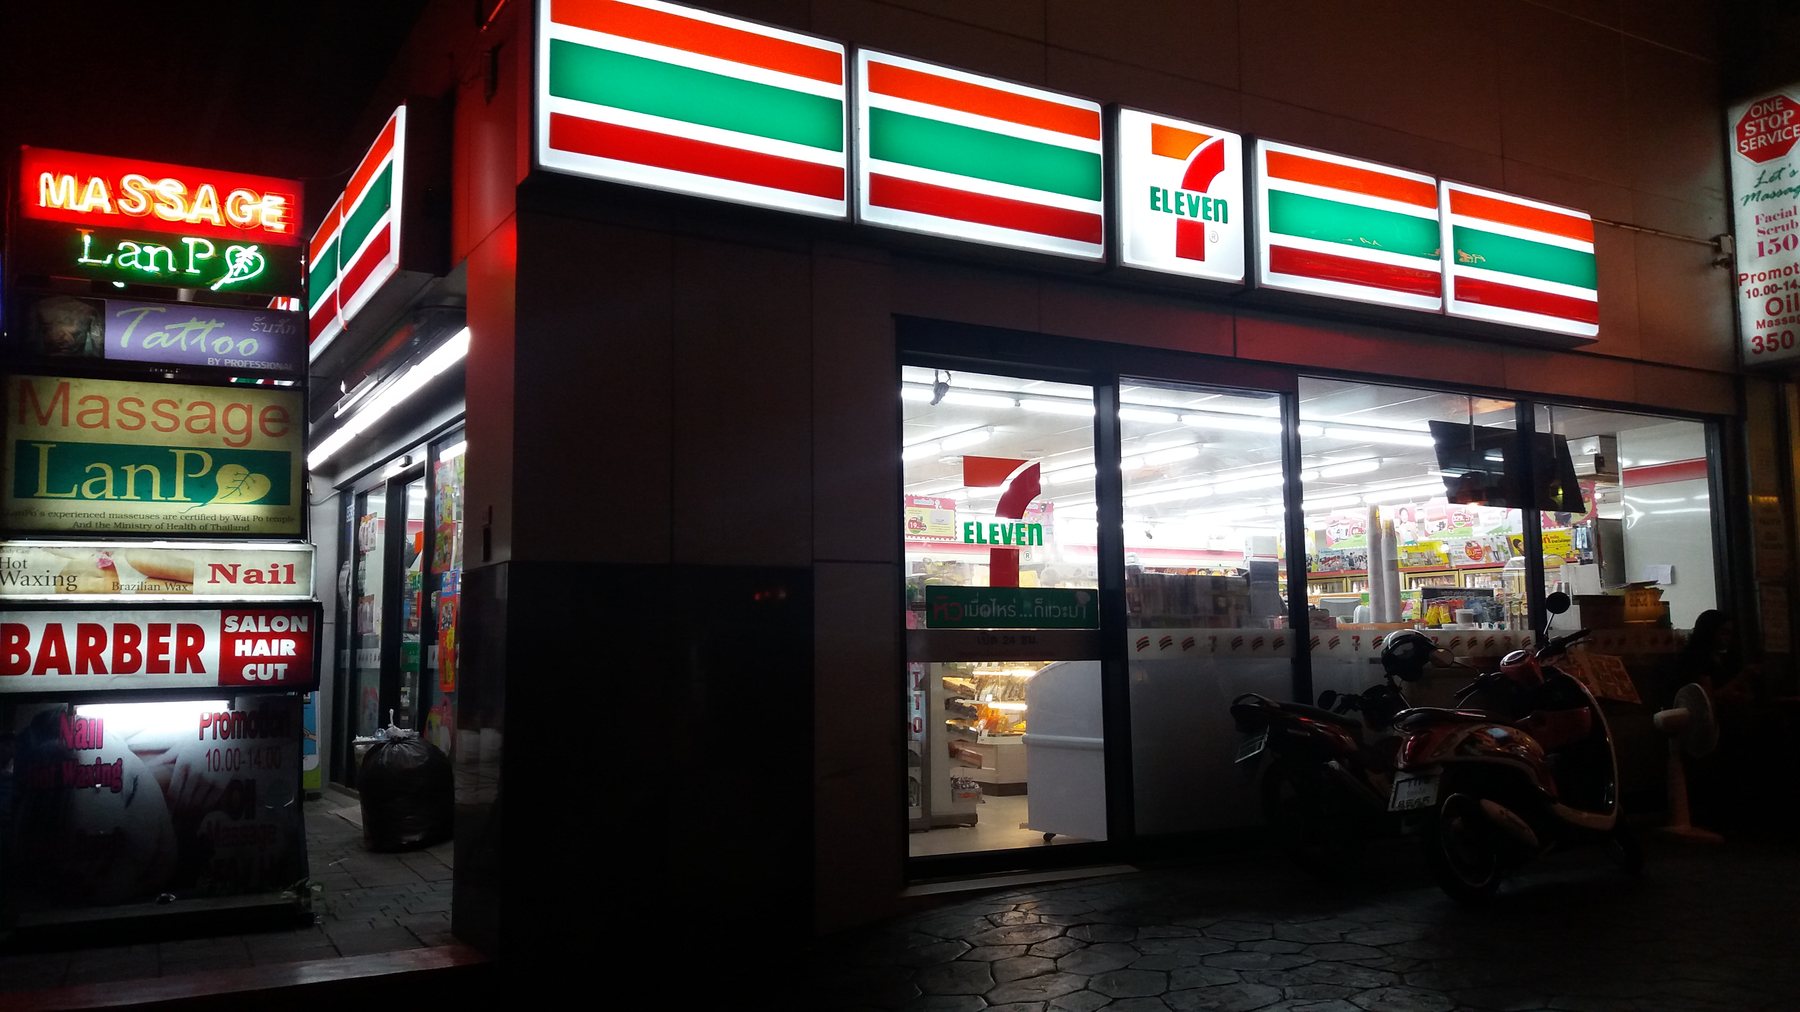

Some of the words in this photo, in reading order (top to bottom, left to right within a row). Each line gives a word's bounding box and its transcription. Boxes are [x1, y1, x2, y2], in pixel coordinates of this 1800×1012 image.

[1750, 97, 1784, 118] ONE
[1744, 109, 1795, 137] STOP
[1740, 123, 1800, 153] SERVICE
[1754, 163, 1799, 188] Let's
[38, 171, 292, 234] MASSAGE
[1754, 205, 1798, 225] Facial
[1756, 219, 1799, 238] Scrub
[1757, 234, 1799, 258] 150
[1765, 292, 1800, 316] Oil
[116, 306, 259, 357] Tattoo
[1751, 330, 1794, 355] 350
[207, 357, 221, 366] BY
[224, 359, 293, 370] PROFESSIONAL
[18, 378, 292, 448] Massage
[47, 510, 106, 520] experienced
[108, 512, 160, 520] masseuses
[180, 513, 216, 521] certified
[219, 514, 230, 523] by
[232, 514, 250, 522] Wat
[252, 514, 264, 522] Po
[72, 521, 92, 529] And
[95, 521, 110, 529] the
[114, 521, 152, 531] Ministry
[155, 522, 164, 530] of
[166, 522, 197, 530] Health
[199, 523, 208, 531] of
[210, 523, 250, 532] Thailand
[0, 557, 28, 569] Hot
[207, 562, 297, 585] Nail
[0, 569, 78, 591] Waxing
[111, 581, 161, 591] Brazilian
[163, 582, 188, 591] Wax
[223, 615, 309, 633] SALON
[0, 622, 207, 675] BARBER
[234, 638, 297, 656] HAIR
[241, 663, 289, 681] CUT
[59, 710, 104, 750] Nail
